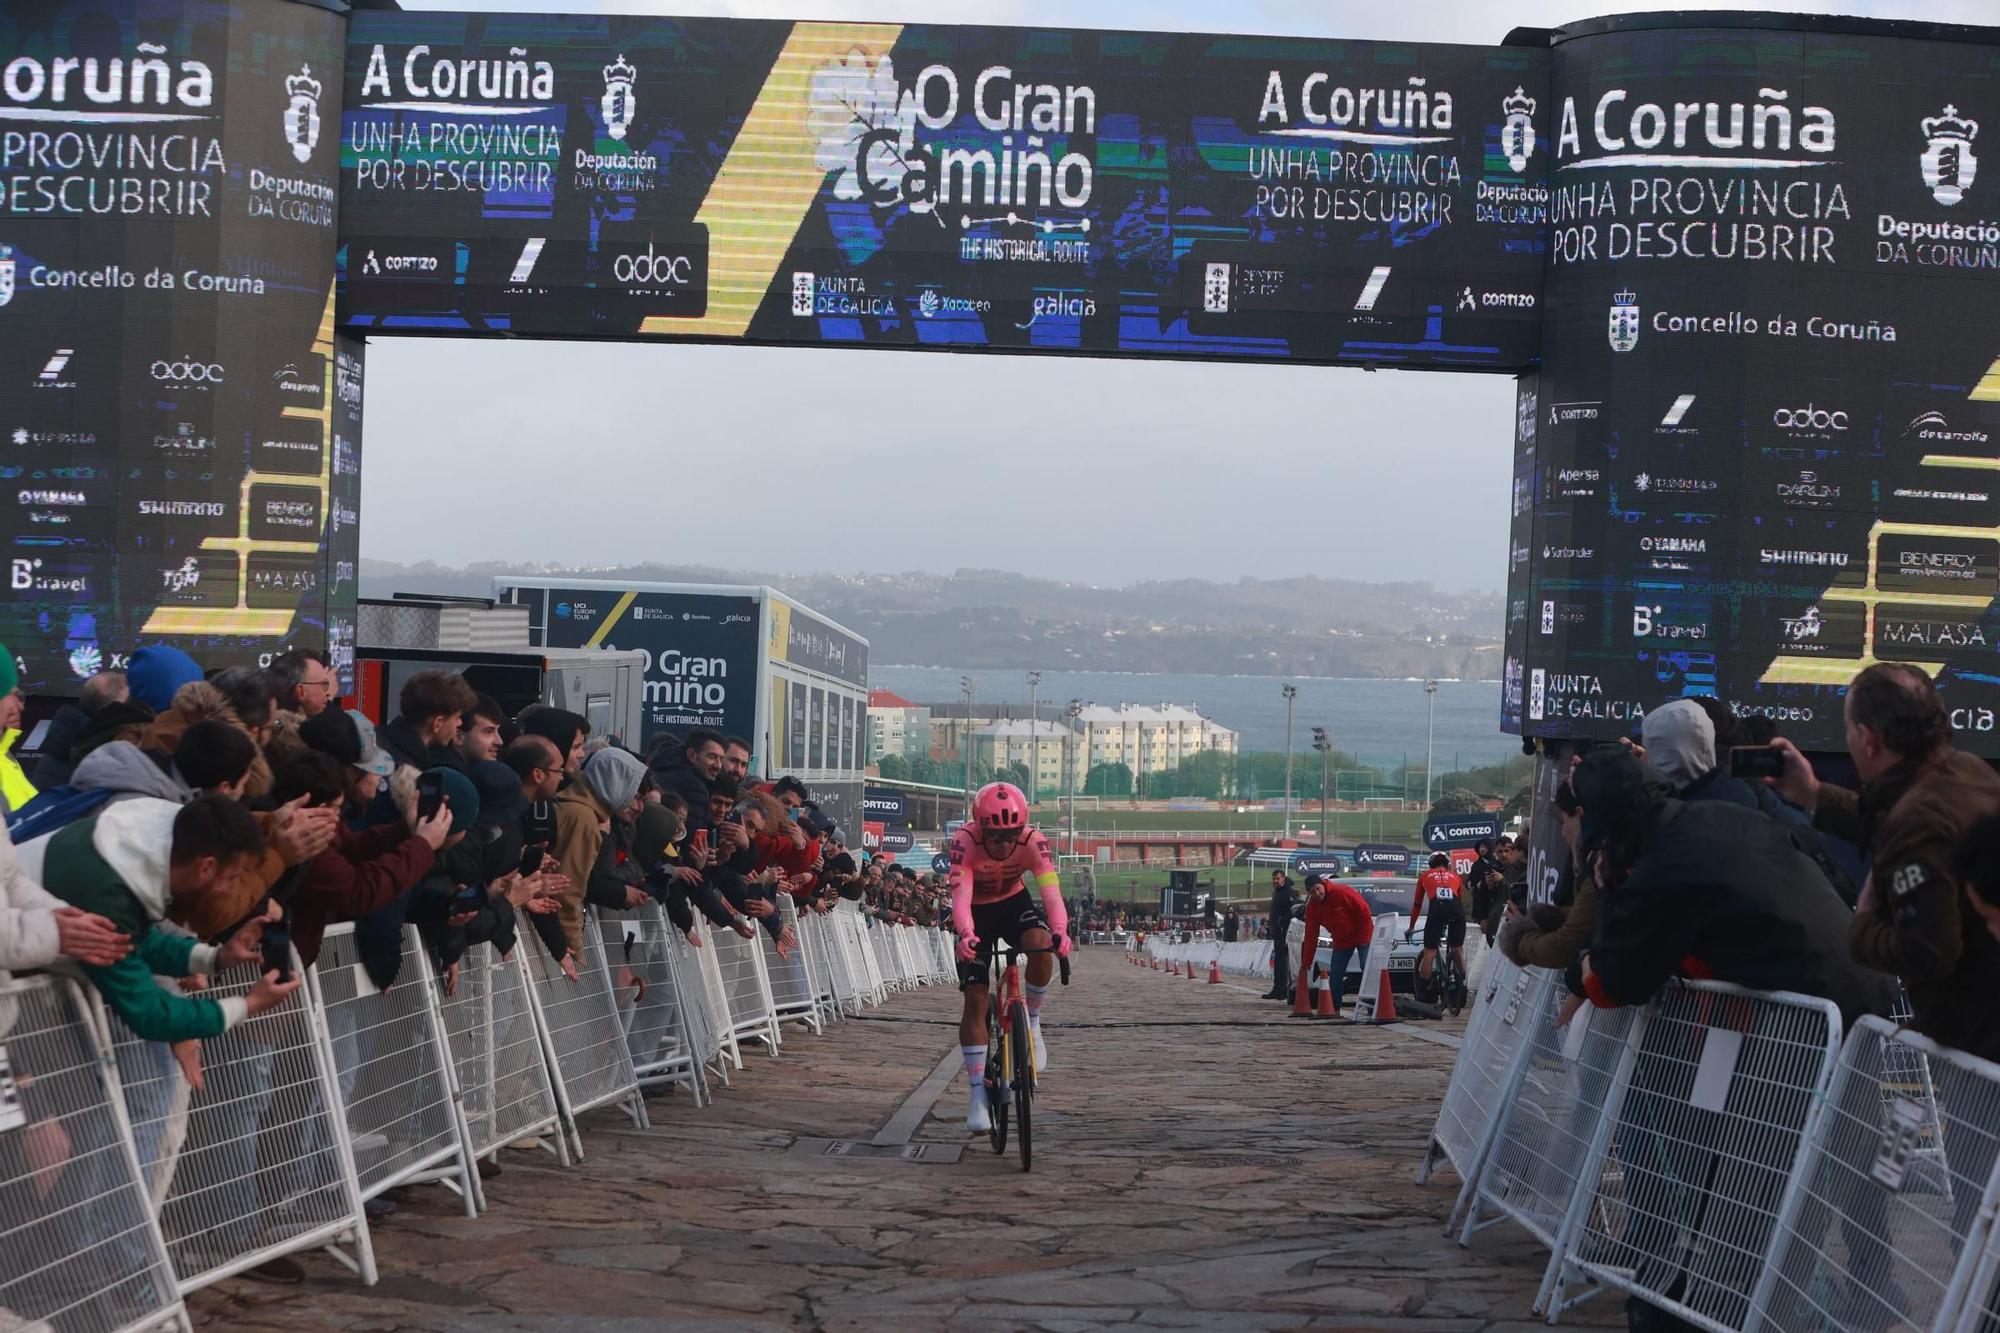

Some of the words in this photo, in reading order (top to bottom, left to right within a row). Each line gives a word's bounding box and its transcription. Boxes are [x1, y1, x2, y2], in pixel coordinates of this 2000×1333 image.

[362, 45, 391, 97] A
[403, 45, 554, 99] Coruña
[914, 65, 959, 129] O
[975, 65, 1095, 134] Gran
[1258, 71, 1288, 123] A
[1302, 72, 1453, 130] Coruña
[1558, 97, 1580, 160] A
[1594, 88, 1836, 152] Coruña
[3, 131, 226, 174] PROVINCIA
[351, 121, 421, 152] UNHA
[429, 122, 561, 157] PROVINCIA
[357, 158, 405, 190] POR
[415, 160, 551, 192] DESCUBRIR
[575, 149, 657, 174] Deputación
[856, 128, 1093, 212] Camiño
[1248, 147, 1321, 181] UNHA
[1329, 151, 1461, 187] PROVINCIA
[250, 168, 334, 202] Deputación
[248, 194, 274, 218] DA
[1256, 185, 1304, 219] POR
[1314, 187, 1452, 224] DESCUBRIR
[1552, 180, 1617, 224] UNHA
[1630, 178, 1851, 220] PROVINCIA
[961, 237, 981, 259] THE
[1053, 241, 1090, 263] ROUTE
[1553, 224, 1597, 265] POR
[1609, 222, 1836, 263] DESCUBRIR
[1876, 241, 1909, 264] DA
[1917, 243, 2000, 269] CORUÑ
[385, 256, 437, 270] CORTIZO
[614, 241, 691, 284] adoc
[30, 266, 134, 289] Concello
[144, 267, 174, 290] da
[184, 270, 265, 295] Coruña
[818, 277, 865, 292] XUNTA
[818, 298, 837, 313] DE
[840, 298, 895, 315] GALICIA
[1020, 289, 1096, 325] galicia
[1482, 292, 1535, 307] CORTIZO
[1653, 311, 1759, 335] Concello
[1768, 314, 1797, 337] da
[1807, 317, 1897, 342] Coruña
[1774, 403, 1848, 430] adoc
[1655, 537, 1706, 552] YAMAHA
[574, 608, 597, 616] EUROPE
[723, 614, 751, 624] galicia
[1884, 622, 1986, 647] MALASA
[660, 650, 727, 678] Gran
[1550, 675, 1602, 695] XUNTA
[652, 714, 665, 724] THE
[665, 715, 702, 725] HISTORICAL
[703, 717, 724, 726] ROUTE
[1548, 698, 1563, 716] DE
[1568, 700, 1645, 720] GALICIA
[1449, 826, 1491, 837] CORTIZO
[1373, 853, 1405, 861] CORTIZO
[1455, 859, 1474, 875] 50
